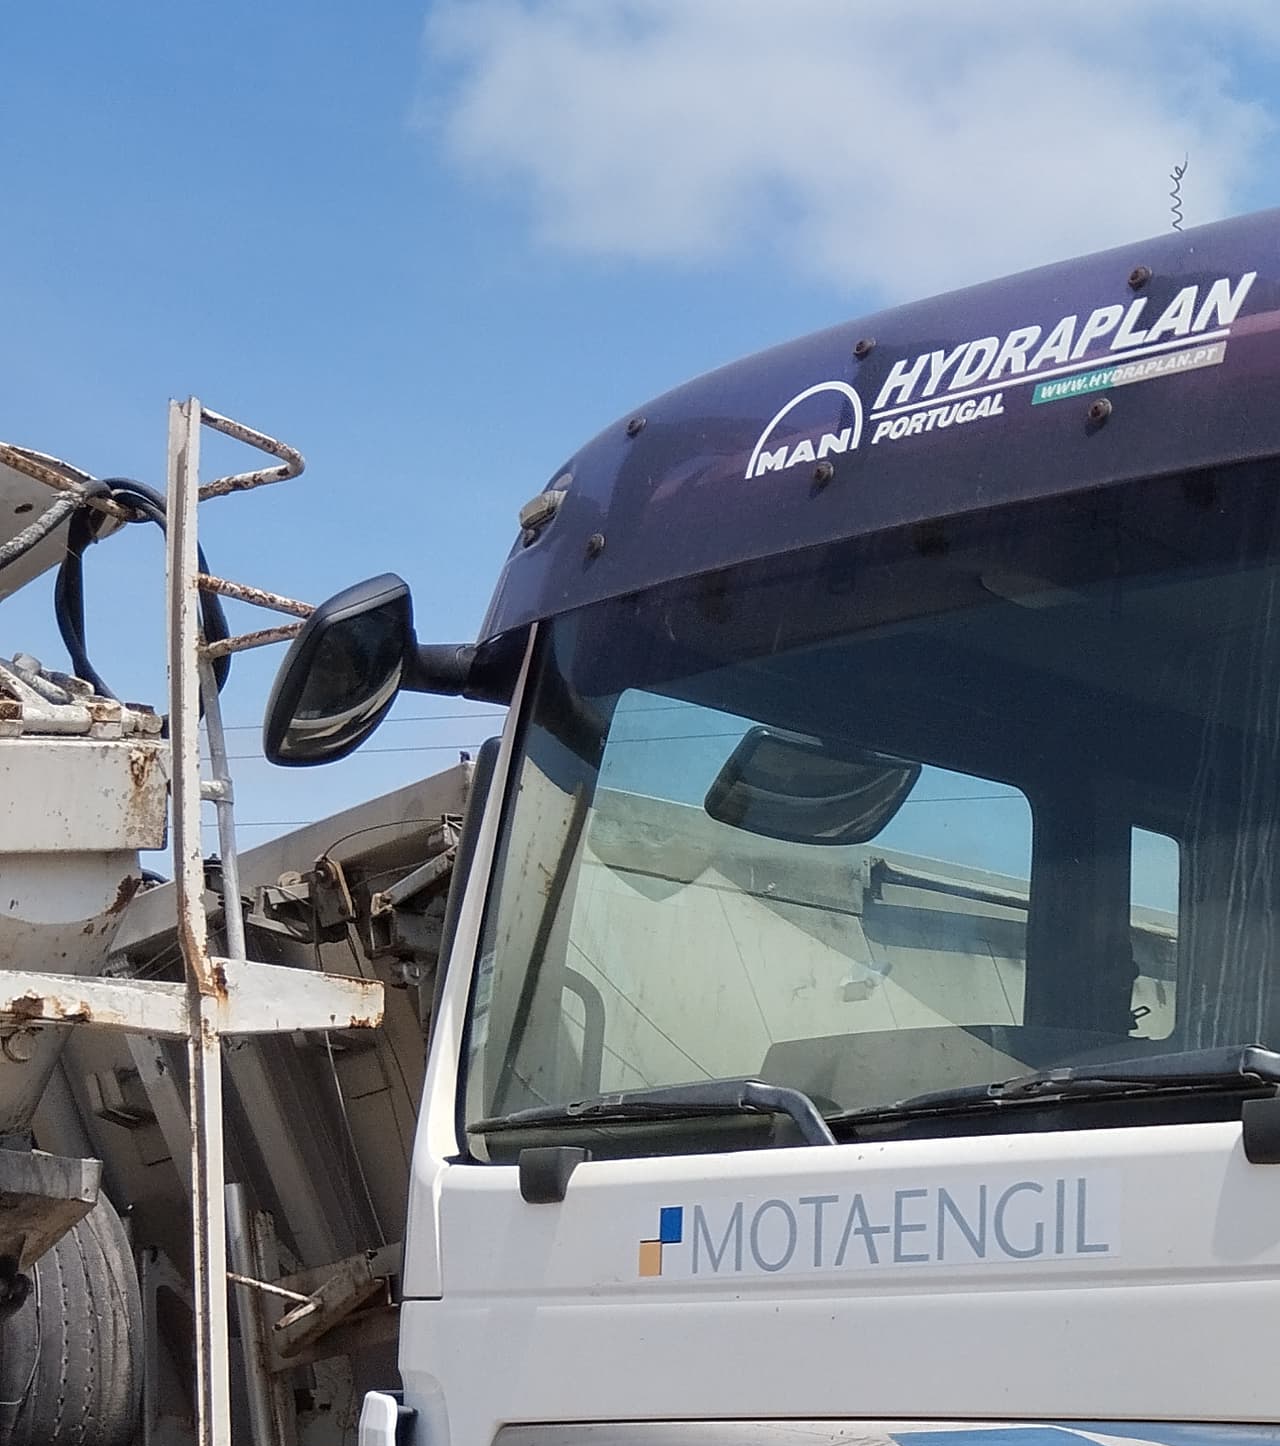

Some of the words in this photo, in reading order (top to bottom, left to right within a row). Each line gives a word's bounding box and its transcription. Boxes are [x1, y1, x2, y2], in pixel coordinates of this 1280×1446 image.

[872, 271, 1257, 411] HYDRAPLAN
[1039, 347, 1218, 399] WWW.HYDRAPLAN.PT
[871, 393, 1005, 445] PORTUGAL
[755, 427, 852, 477] MAN
